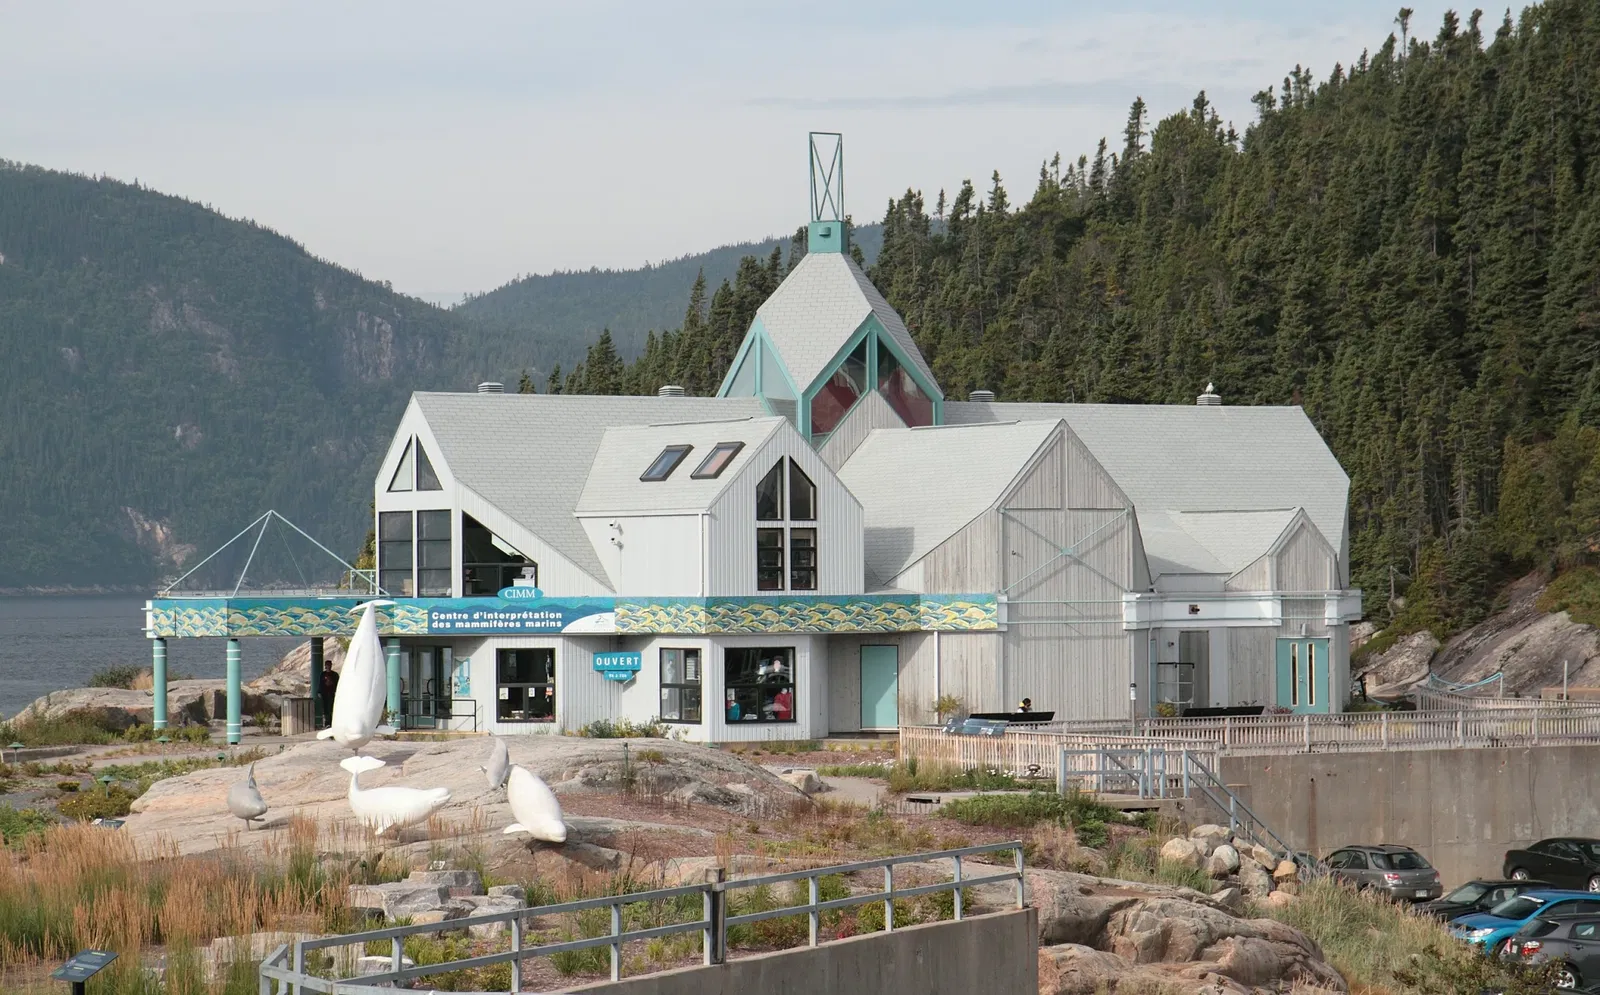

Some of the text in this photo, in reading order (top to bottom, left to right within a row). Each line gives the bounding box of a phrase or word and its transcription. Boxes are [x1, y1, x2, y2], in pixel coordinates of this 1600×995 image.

[505, 589, 536, 599] CIMM
[432, 611, 562, 621] Centre d'interprétation
[432, 620, 562, 628] des mammifères marins
[596, 656, 639, 666] OUVERT
